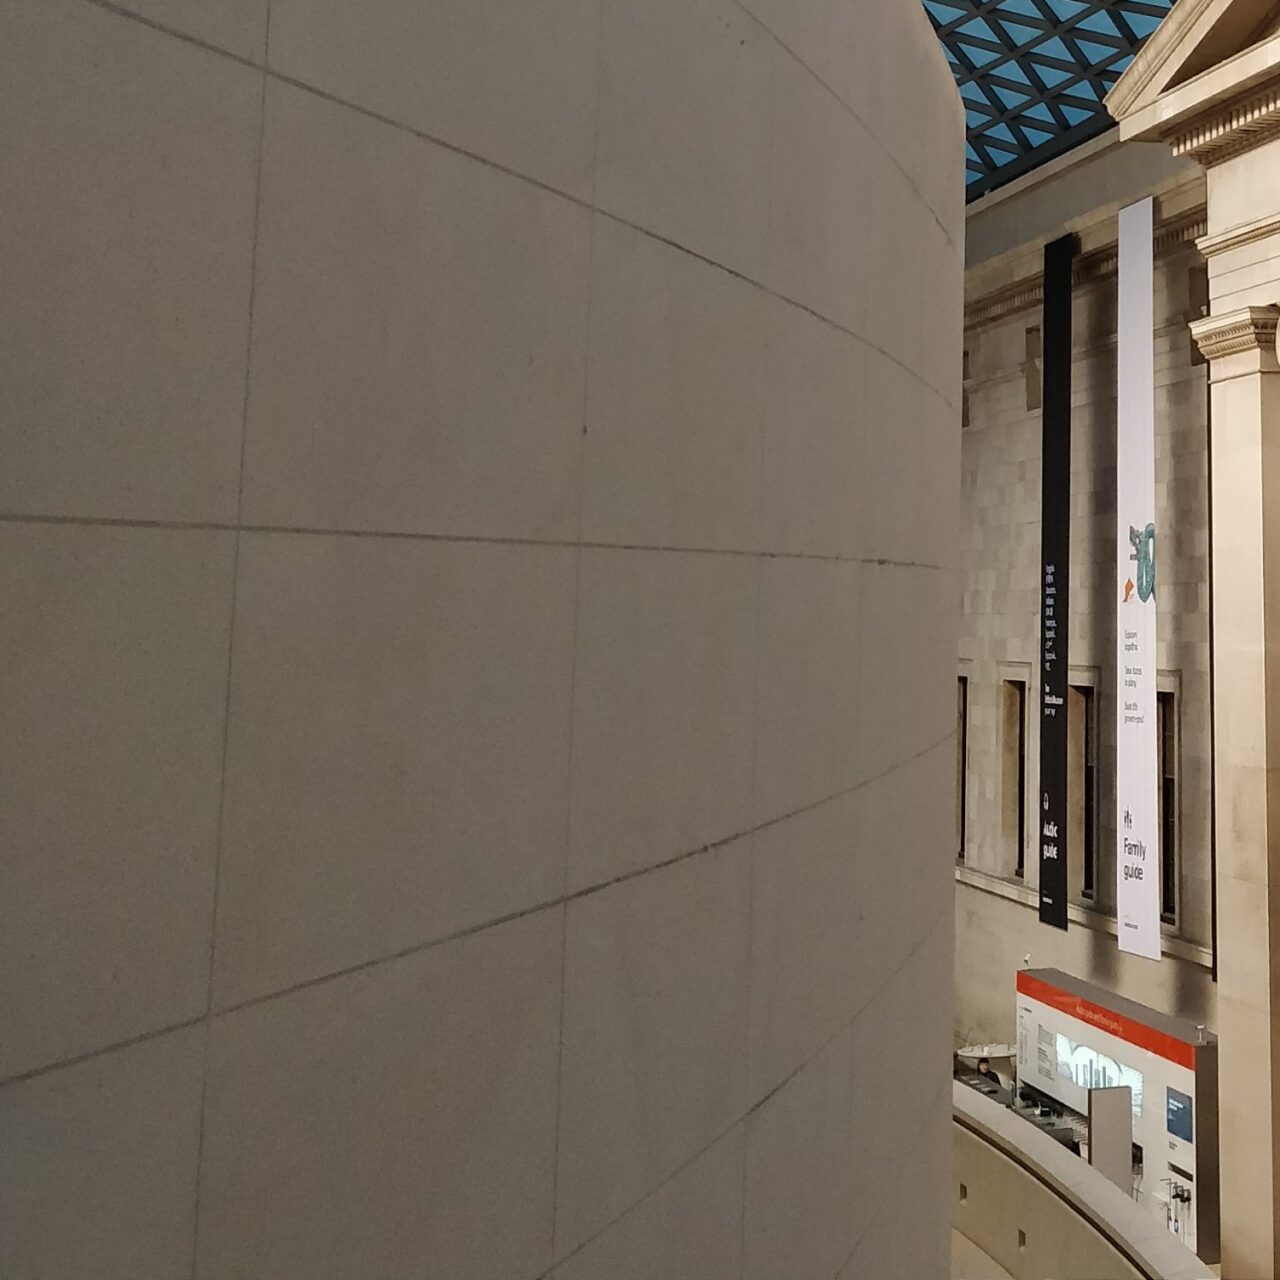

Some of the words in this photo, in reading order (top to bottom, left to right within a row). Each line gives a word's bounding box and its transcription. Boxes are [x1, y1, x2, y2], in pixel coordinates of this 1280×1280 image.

[1043, 842, 1058, 860] guide
[1123, 837, 1147, 861] Family
[1123, 863, 1144, 881] guide
